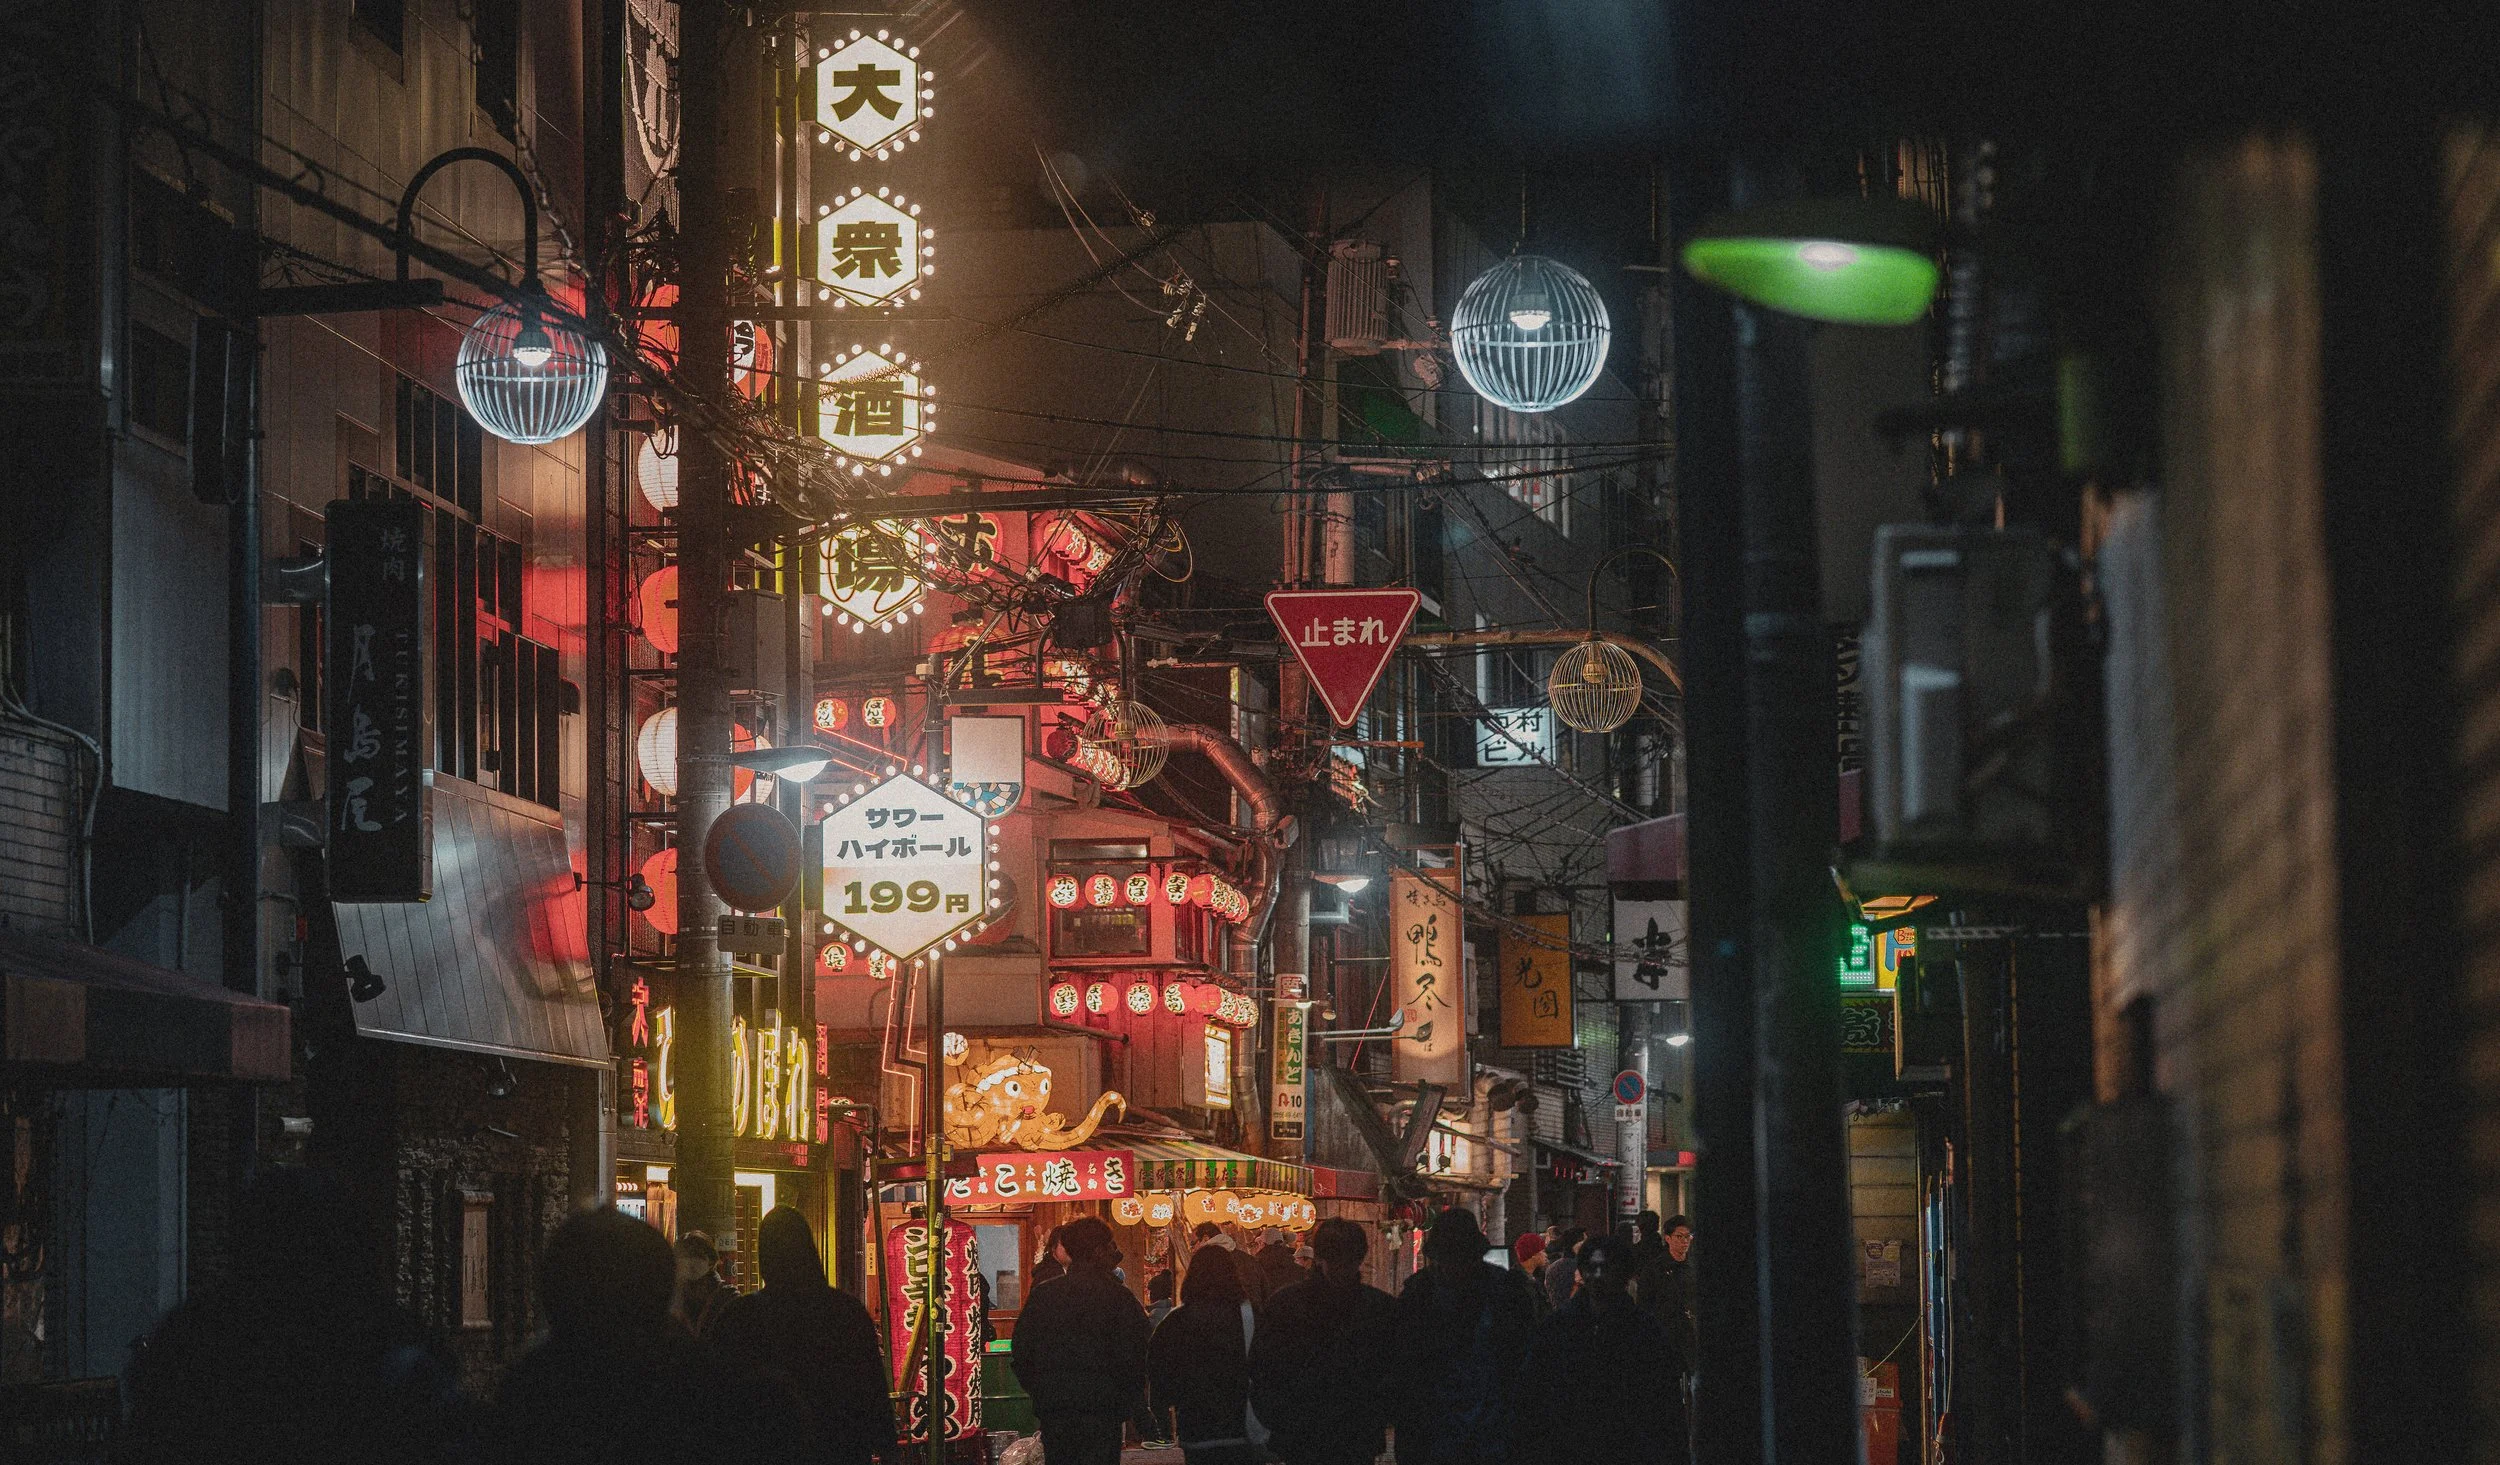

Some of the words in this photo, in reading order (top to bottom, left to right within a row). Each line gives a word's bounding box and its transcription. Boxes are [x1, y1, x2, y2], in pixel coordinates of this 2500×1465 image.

[381, 527, 407, 581] 焼肉
[1300, 616, 1389, 647] 止まれ
[394, 628, 408, 825] TUKISIMAYA
[1485, 739, 1546, 762] ビル
[865, 807, 944, 829] サワー
[837, 834, 972, 860] ハイボール
[843, 879, 970, 915] 199円
[721, 919, 782, 938] 自動車
[1286, 1009, 1303, 1082] あきんど
[1290, 1095, 1303, 1109] 10
